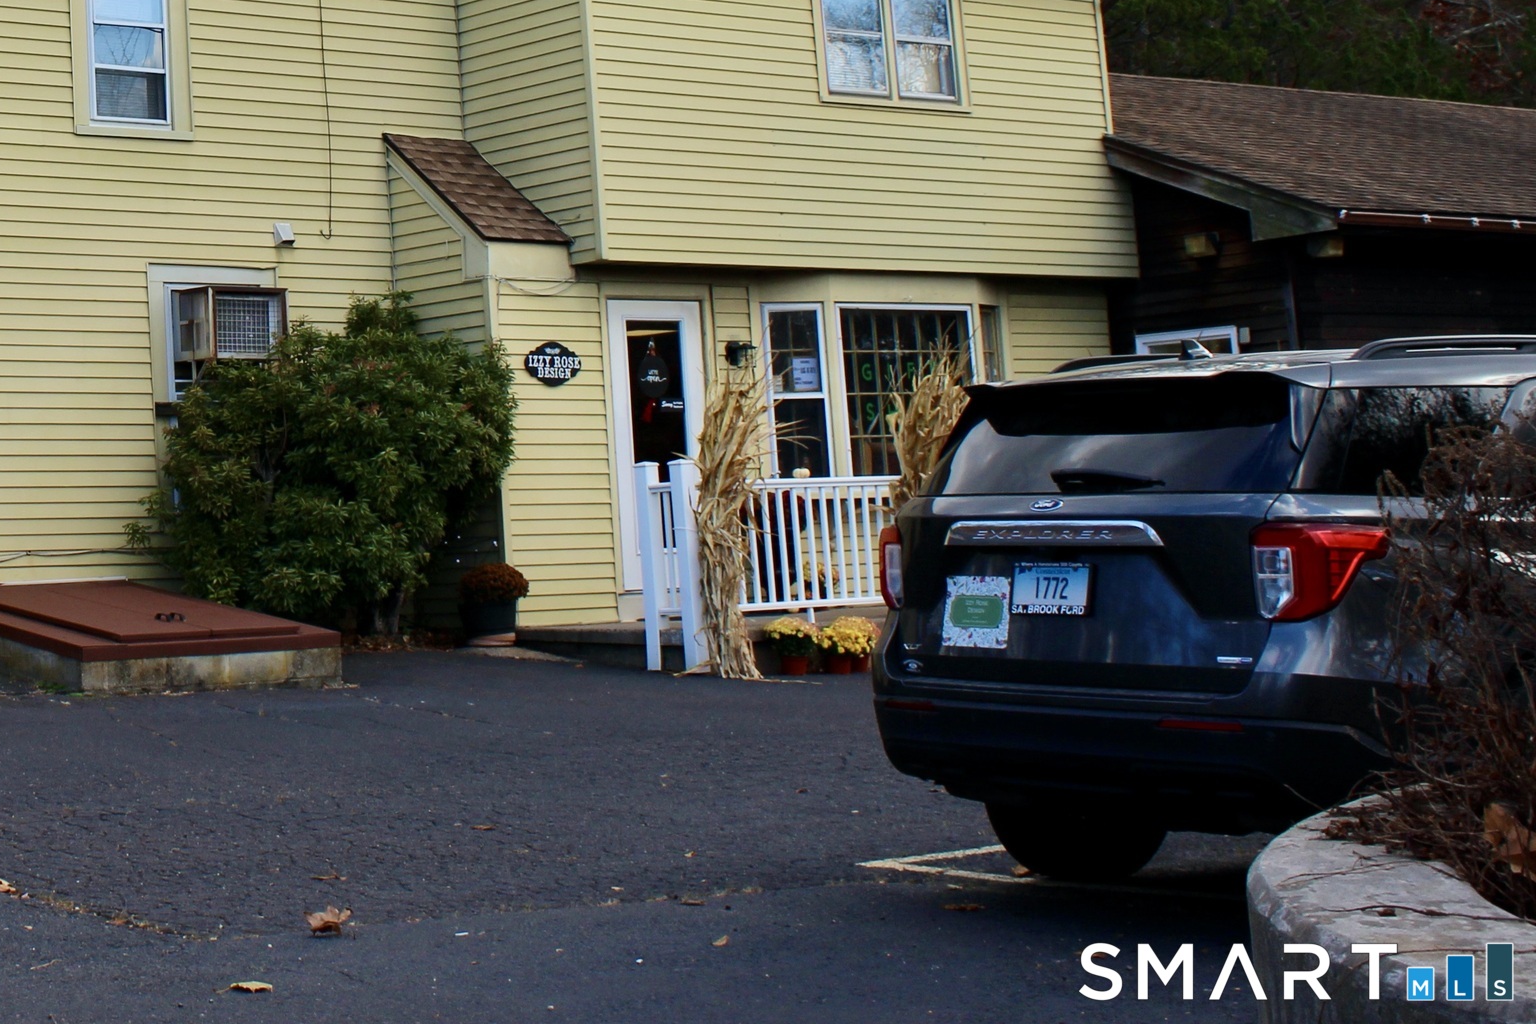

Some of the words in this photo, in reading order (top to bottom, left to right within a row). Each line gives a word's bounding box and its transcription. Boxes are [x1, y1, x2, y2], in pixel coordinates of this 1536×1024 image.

[528, 355, 551, 367] IZZY
[554, 356, 580, 369] ROSE
[537, 367, 572, 378] DESIGN
[972, 530, 1113, 540] EXPLORER
[1035, 576, 1069, 599] 1772
